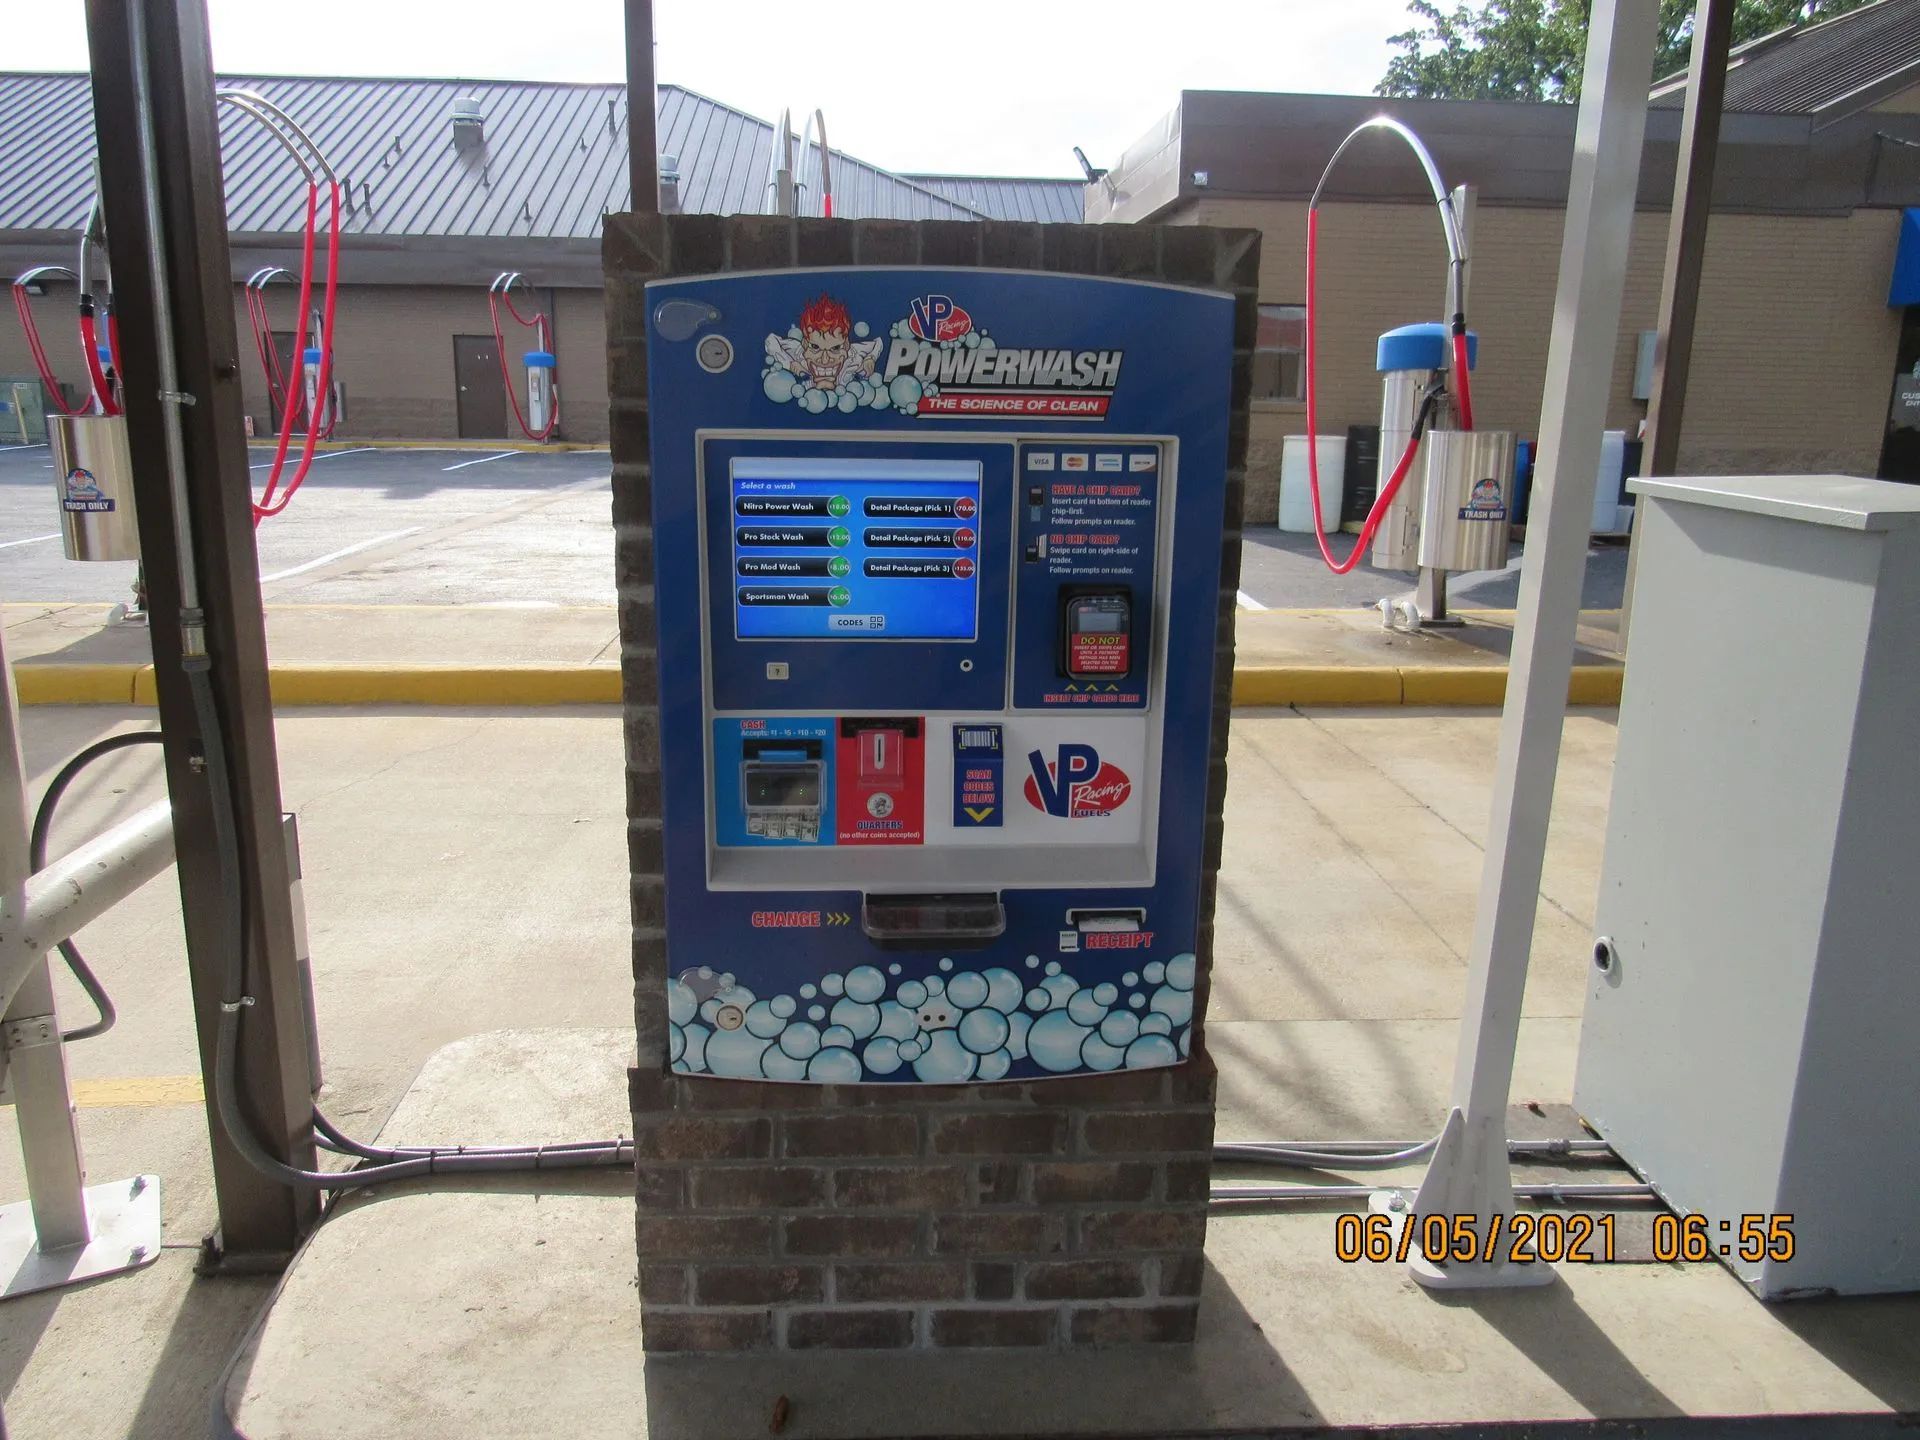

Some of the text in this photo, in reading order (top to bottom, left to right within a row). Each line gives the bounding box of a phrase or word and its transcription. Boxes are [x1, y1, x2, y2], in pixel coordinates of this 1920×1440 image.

[911, 295, 953, 340] VP
[939, 320, 970, 335] Racing
[883, 338, 1122, 387] POWERWASH
[929, 398, 1098, 411] THE SCIENCE OF CLEAN
[741, 482, 764, 490] Select
[774, 482, 796, 490] wash
[1052, 484, 1076, 495] HAVE
[1077, 485, 1085, 495] A
[1086, 485, 1108, 495] CHIP
[65, 502, 109, 510] TRASH ONLY
[1130, 498, 1152, 506] reader
[893, 504, 923, 513] Package
[924, 504, 942, 513] (Pick
[944, 504, 952, 513] 1)
[1052, 508, 1084, 516] chip-first.
[1464, 510, 1488, 518] TRASH
[1074, 518, 1102, 526] prompts
[893, 534, 922, 543] Package
[924, 534, 941, 543] (Pick
[943, 534, 950, 543] 2)
[1050, 534, 1064, 544] NO
[1066, 534, 1088, 544] CHIP
[1050, 547, 1070, 555] Swipe
[893, 564, 922, 573] Package
[924, 564, 940, 573] (Pick
[942, 564, 950, 573] 3)
[746, 593, 786, 601] Sportsman
[1081, 636, 1120, 644] DO NOT
[740, 720, 766, 730] CASH
[741, 729, 769, 737] Accepts:
[966, 769, 992, 779] SCAN
[1028, 744, 1100, 818] VP
[964, 782, 994, 791] CODES
[963, 794, 995, 803] BELOW
[1074, 780, 1131, 808] Racing
[857, 820, 904, 830] QUARTERS
[752, 911, 820, 928] CHANGE
[1086, 932, 1154, 949] RECEIPT
